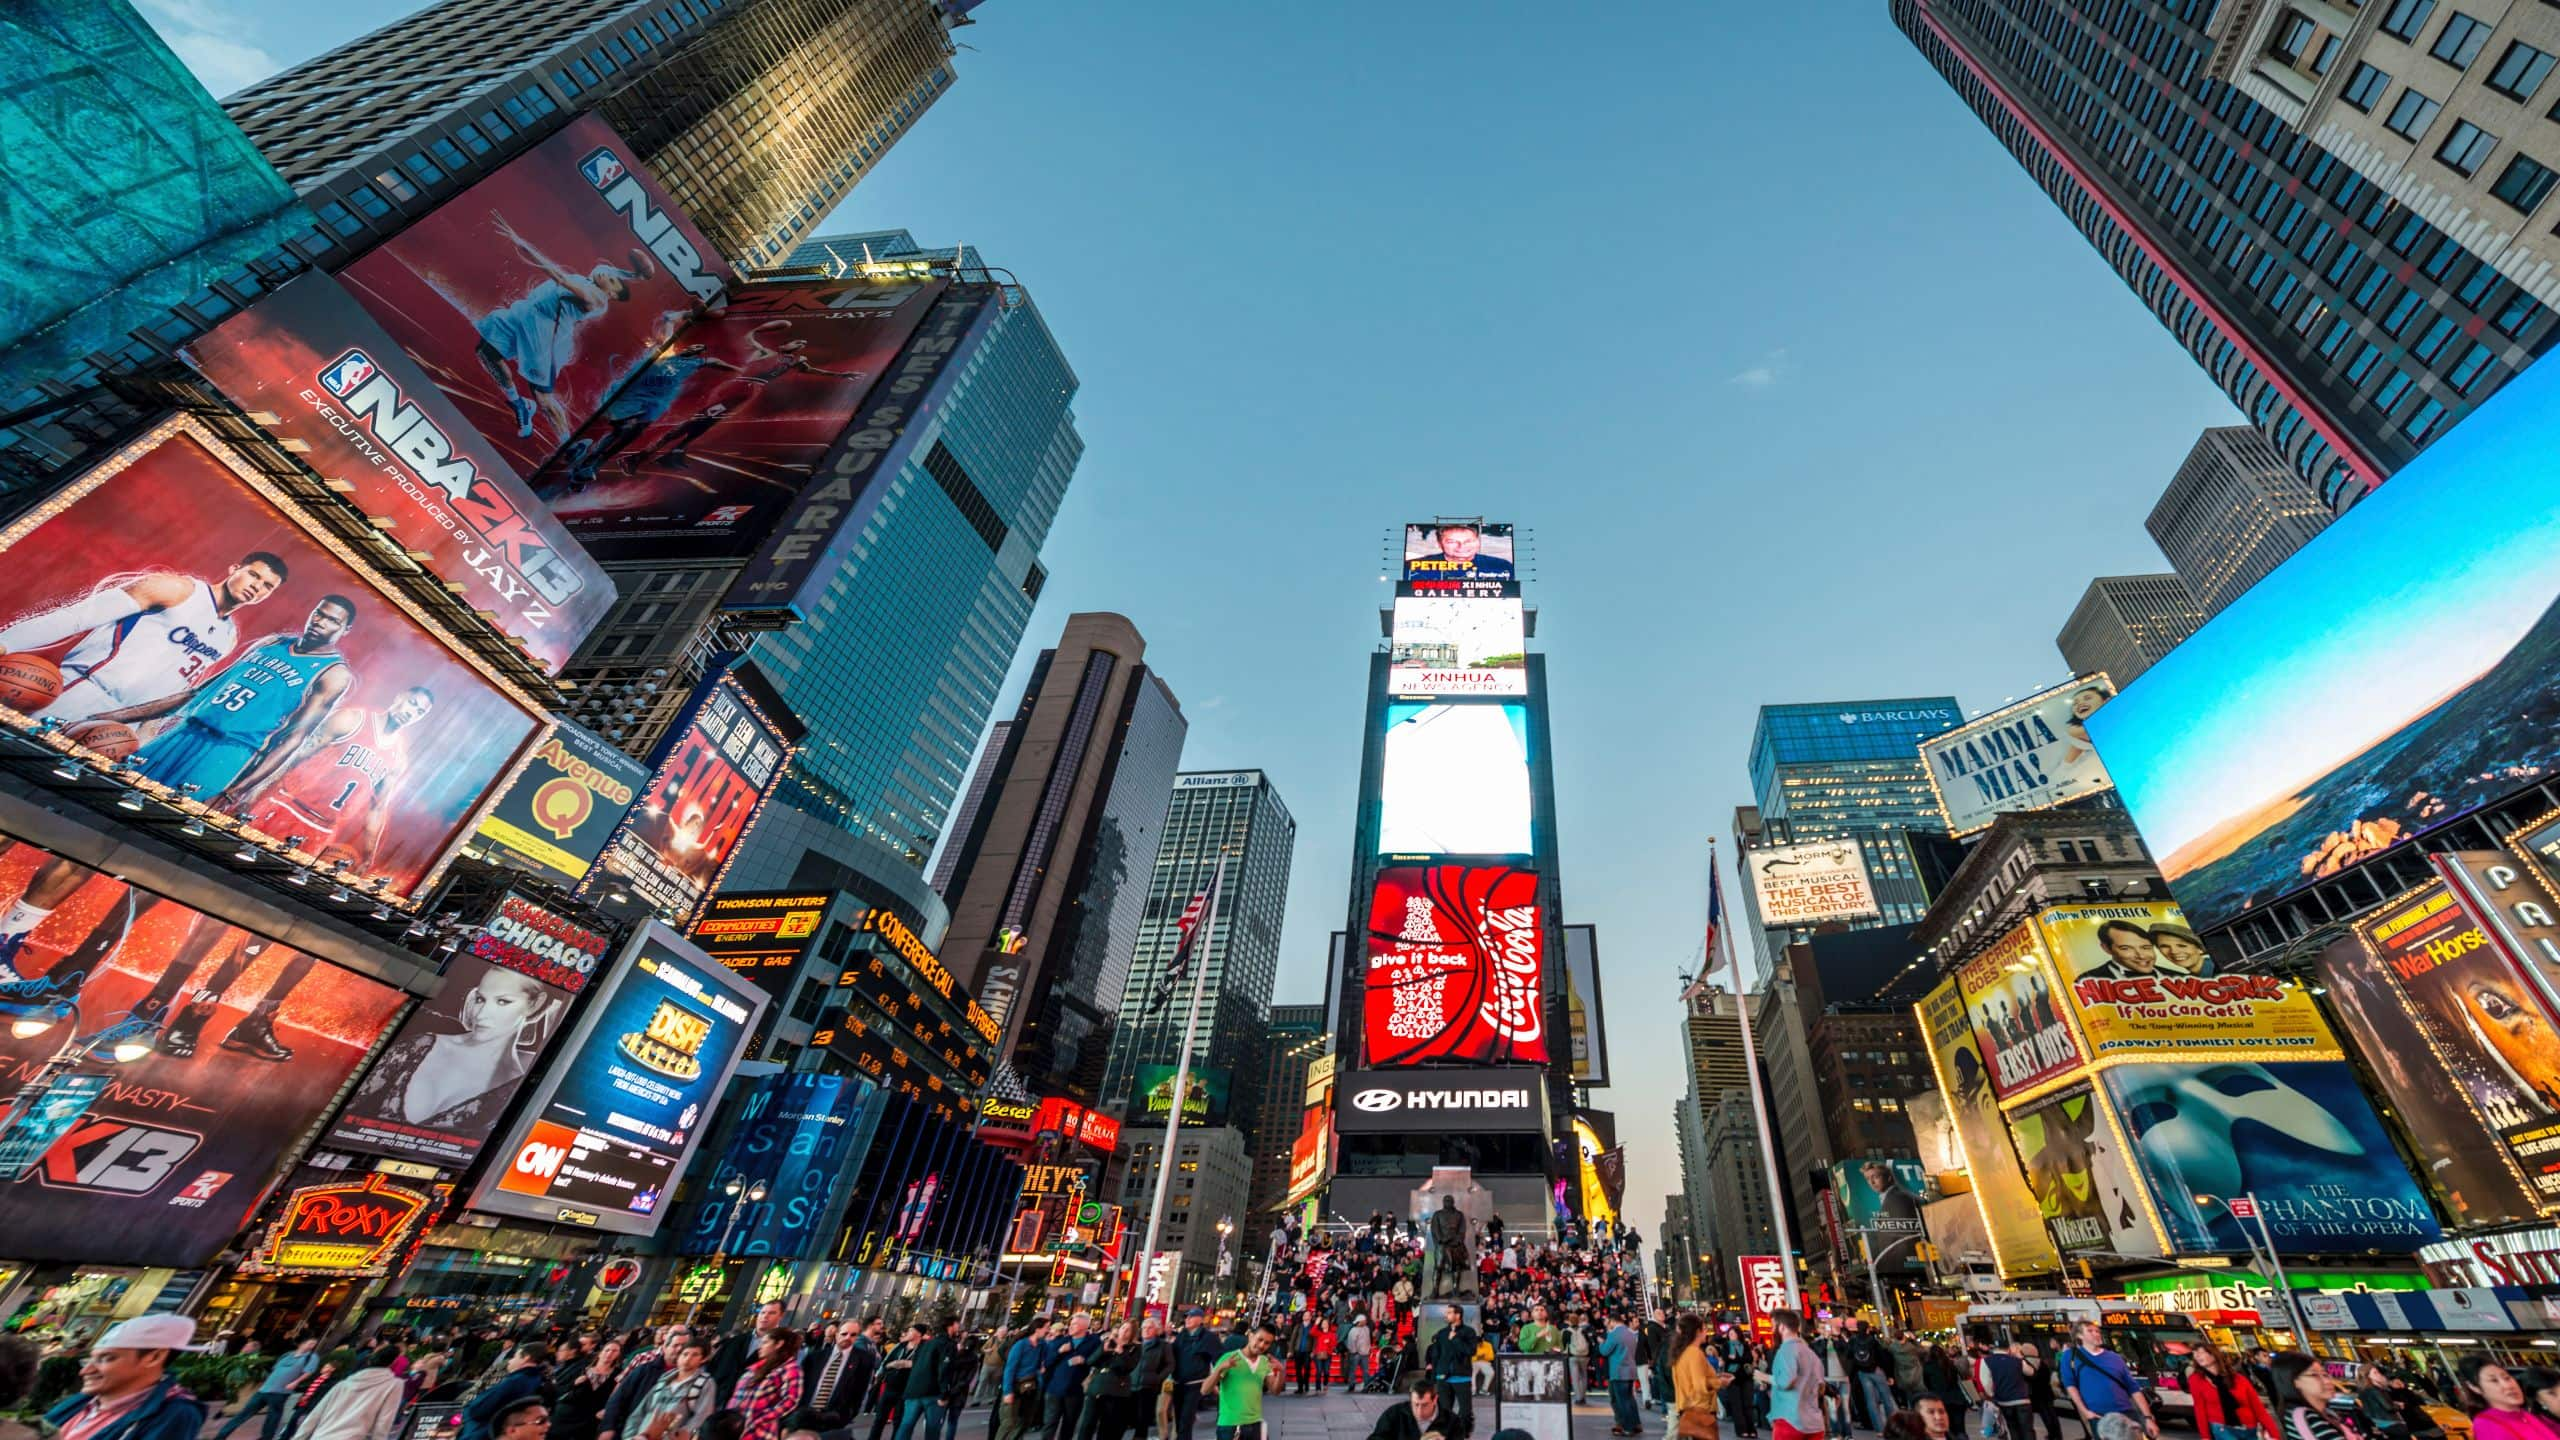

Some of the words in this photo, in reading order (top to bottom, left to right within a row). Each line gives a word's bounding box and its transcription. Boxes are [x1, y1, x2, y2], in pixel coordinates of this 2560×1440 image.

[600, 176, 729, 311] NBA
[825, 311, 874, 320] JAY
[891, 302, 980, 395] TIMES
[299, 389, 388, 466] EXECUTIVE
[384, 466, 456, 531] PRODUCED
[454, 527, 474, 545] BY
[771, 406, 905, 561] SQUARE
[1411, 561, 1458, 570] PETER
[461, 548, 530, 603] JAY
[522, 604, 553, 629] Z
[749, 581, 788, 591] NYC
[1414, 589, 1502, 597] GALLERY
[1462, 581, 1503, 589] XINHUA
[243, 667, 275, 685] CITY
[1422, 673, 1496, 682] XINHUA
[211, 684, 257, 712] 35
[712, 693, 737, 724] RICKY
[699, 708, 729, 744] MARTIN
[1861, 708, 1950, 723] BARCLAYS
[574, 739, 592, 752] BEST
[593, 751, 622, 771] MUSICAL
[1937, 715, 2058, 781] MAMMA
[533, 738, 633, 806] Avenue
[1182, 775, 1229, 786] Allianz
[1972, 753, 2048, 805] MIA!
[332, 781, 358, 811] 1
[532, 776, 593, 840] Q
[647, 727, 760, 864] EVITA
[1764, 880, 1794, 889] BEST
[1800, 873, 1860, 886] MUSICAL
[1810, 881, 1861, 896] BEST
[716, 898, 774, 909] THOMSON
[774, 897, 827, 907] REUTERS
[1768, 896, 1837, 909] MUSICAL
[1842, 892, 1864, 901] OF
[1770, 907, 1801, 917] THIS
[2080, 907, 2152, 920] BRODERICK
[503, 896, 606, 956] CHICAGO
[704, 920, 776, 932] COMMODITIES
[714, 933, 757, 943] ENERGY
[488, 917, 595, 973] CHICAGO
[878, 911, 940, 981] CONFERENCE
[934, 967, 955, 999] CALL
[1962, 960, 1986, 980] THE
[1985, 925, 2031, 965] CROWD
[475, 936, 584, 992] CHICAGO
[763, 956, 793, 967] GAS
[1371, 954, 1407, 969] give
[1411, 953, 1424, 966] it
[1428, 953, 1467, 967] back
[1478, 897, 1540, 1043] Coca-Cola
[1967, 967, 1999, 995] GOES
[2074, 977, 2166, 1007] NICE
[2160, 976, 2285, 1005] WORK
[2117, 1005, 2132, 1019] If
[2137, 1006, 2167, 1019] You
[2169, 1004, 2201, 1017] Can
[2204, 1005, 2236, 1017] Get
[649, 1004, 708, 1055] DISH
[2176, 1038, 2235, 1047] FUNNIEST
[2238, 1037, 2273, 1046] LOVE
[2275, 1037, 2315, 1046] STORY
[627, 1036, 700, 1077] NATION
[1995, 1037, 2042, 1089] JERSEY
[2034, 1021, 2076, 1069] BOYS
[982, 1098, 1034, 1119] Reese's
[1407, 1090, 1529, 1109] HYUNDAI
[778, 1111, 815, 1121] Morgan
[815, 1113, 846, 1126] Stanley
[516, 1142, 564, 1178] CNN
[1024, 1163, 1084, 1193] HEY'S
[2306, 1184, 2349, 1197] THE
[168, 1197, 207, 1208] SPORTS
[2257, 1198, 2429, 1221] PHANTOM
[2274, 1222, 2299, 1235] OF
[2304, 1222, 2349, 1236] THE
[2351, 1222, 2423, 1235] OPERA
[286, 1247, 363, 1264] DELICATESSEN
[1753, 1261, 1790, 1314] tkts
[2173, 1285, 2211, 1312] sbarro
